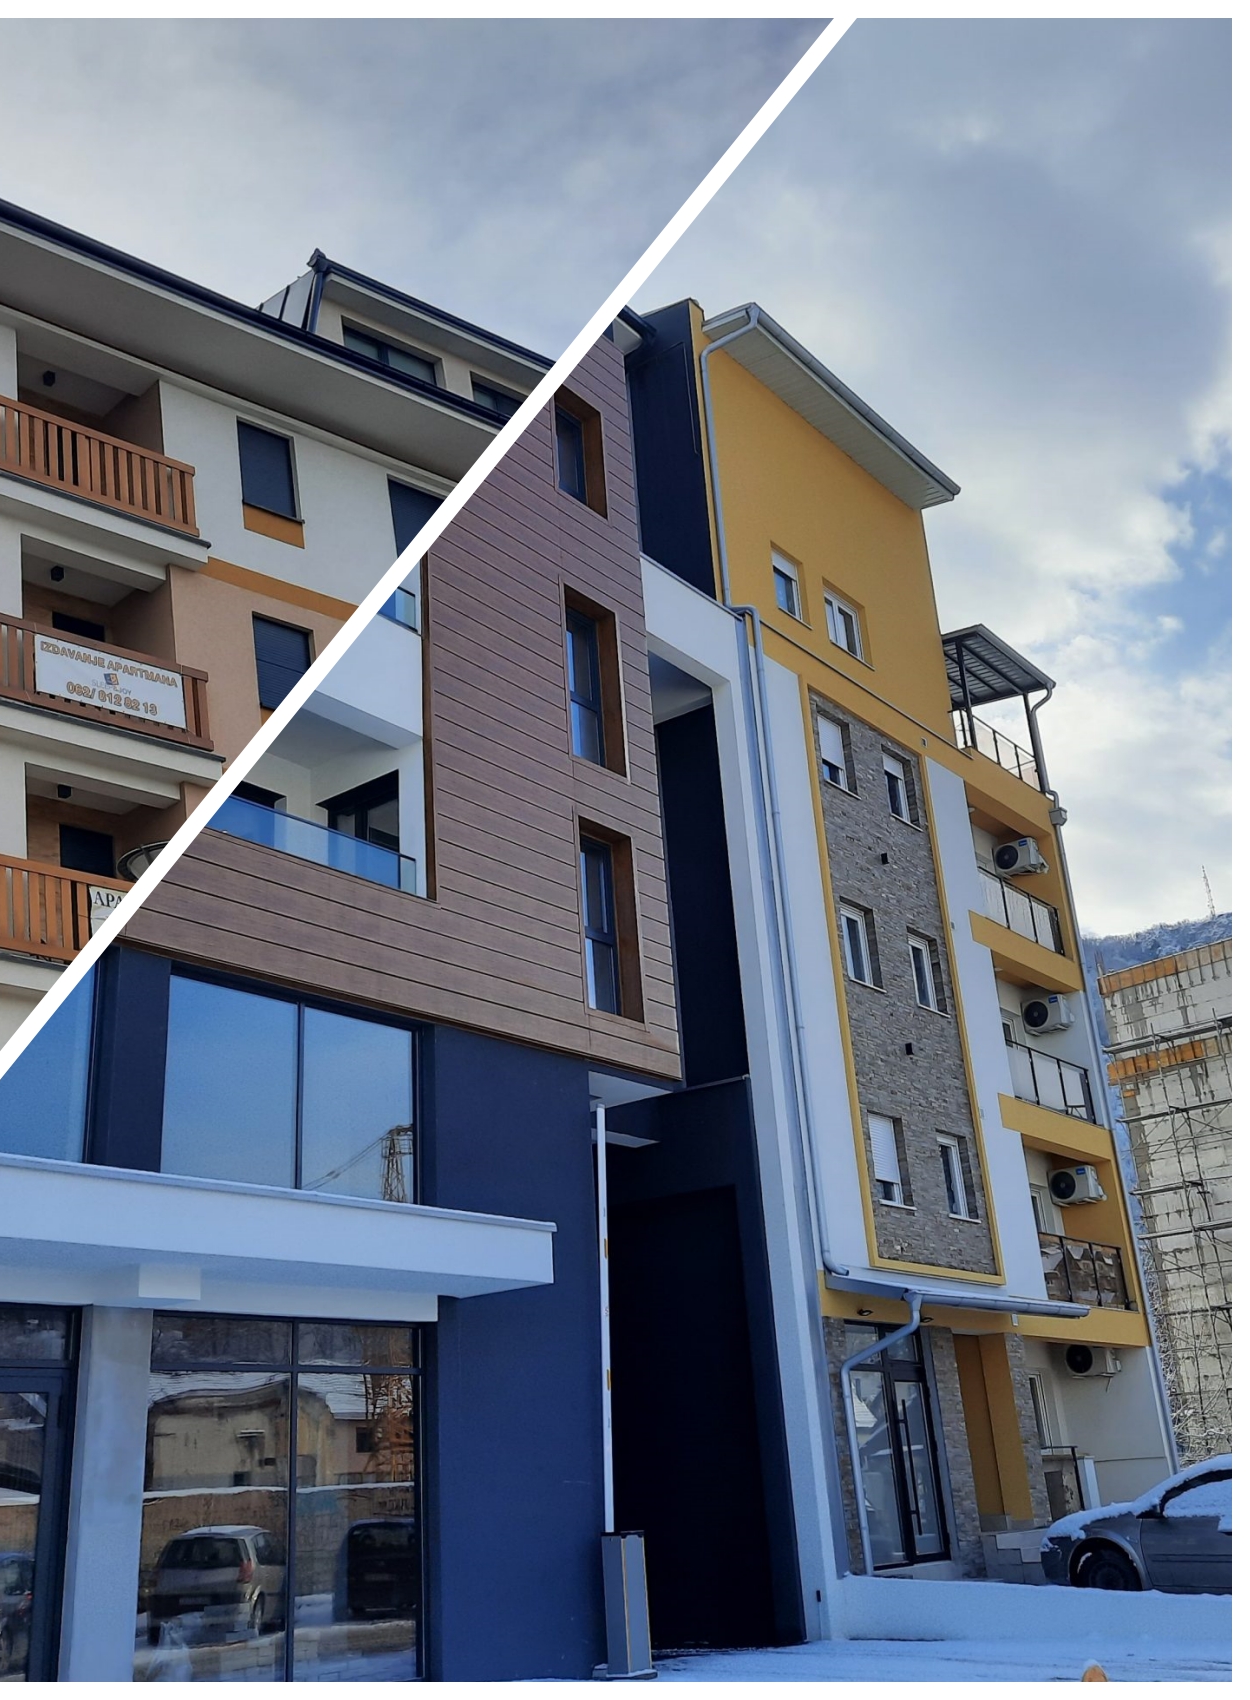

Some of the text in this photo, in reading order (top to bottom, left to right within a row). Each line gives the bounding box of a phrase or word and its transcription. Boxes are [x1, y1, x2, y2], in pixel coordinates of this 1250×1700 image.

[40, 641, 178, 688] IZDAVANJE APARTMANA
[98, 690, 122, 707] 812
[123, 696, 140, 711] 82
[142, 702, 158, 716] 13
